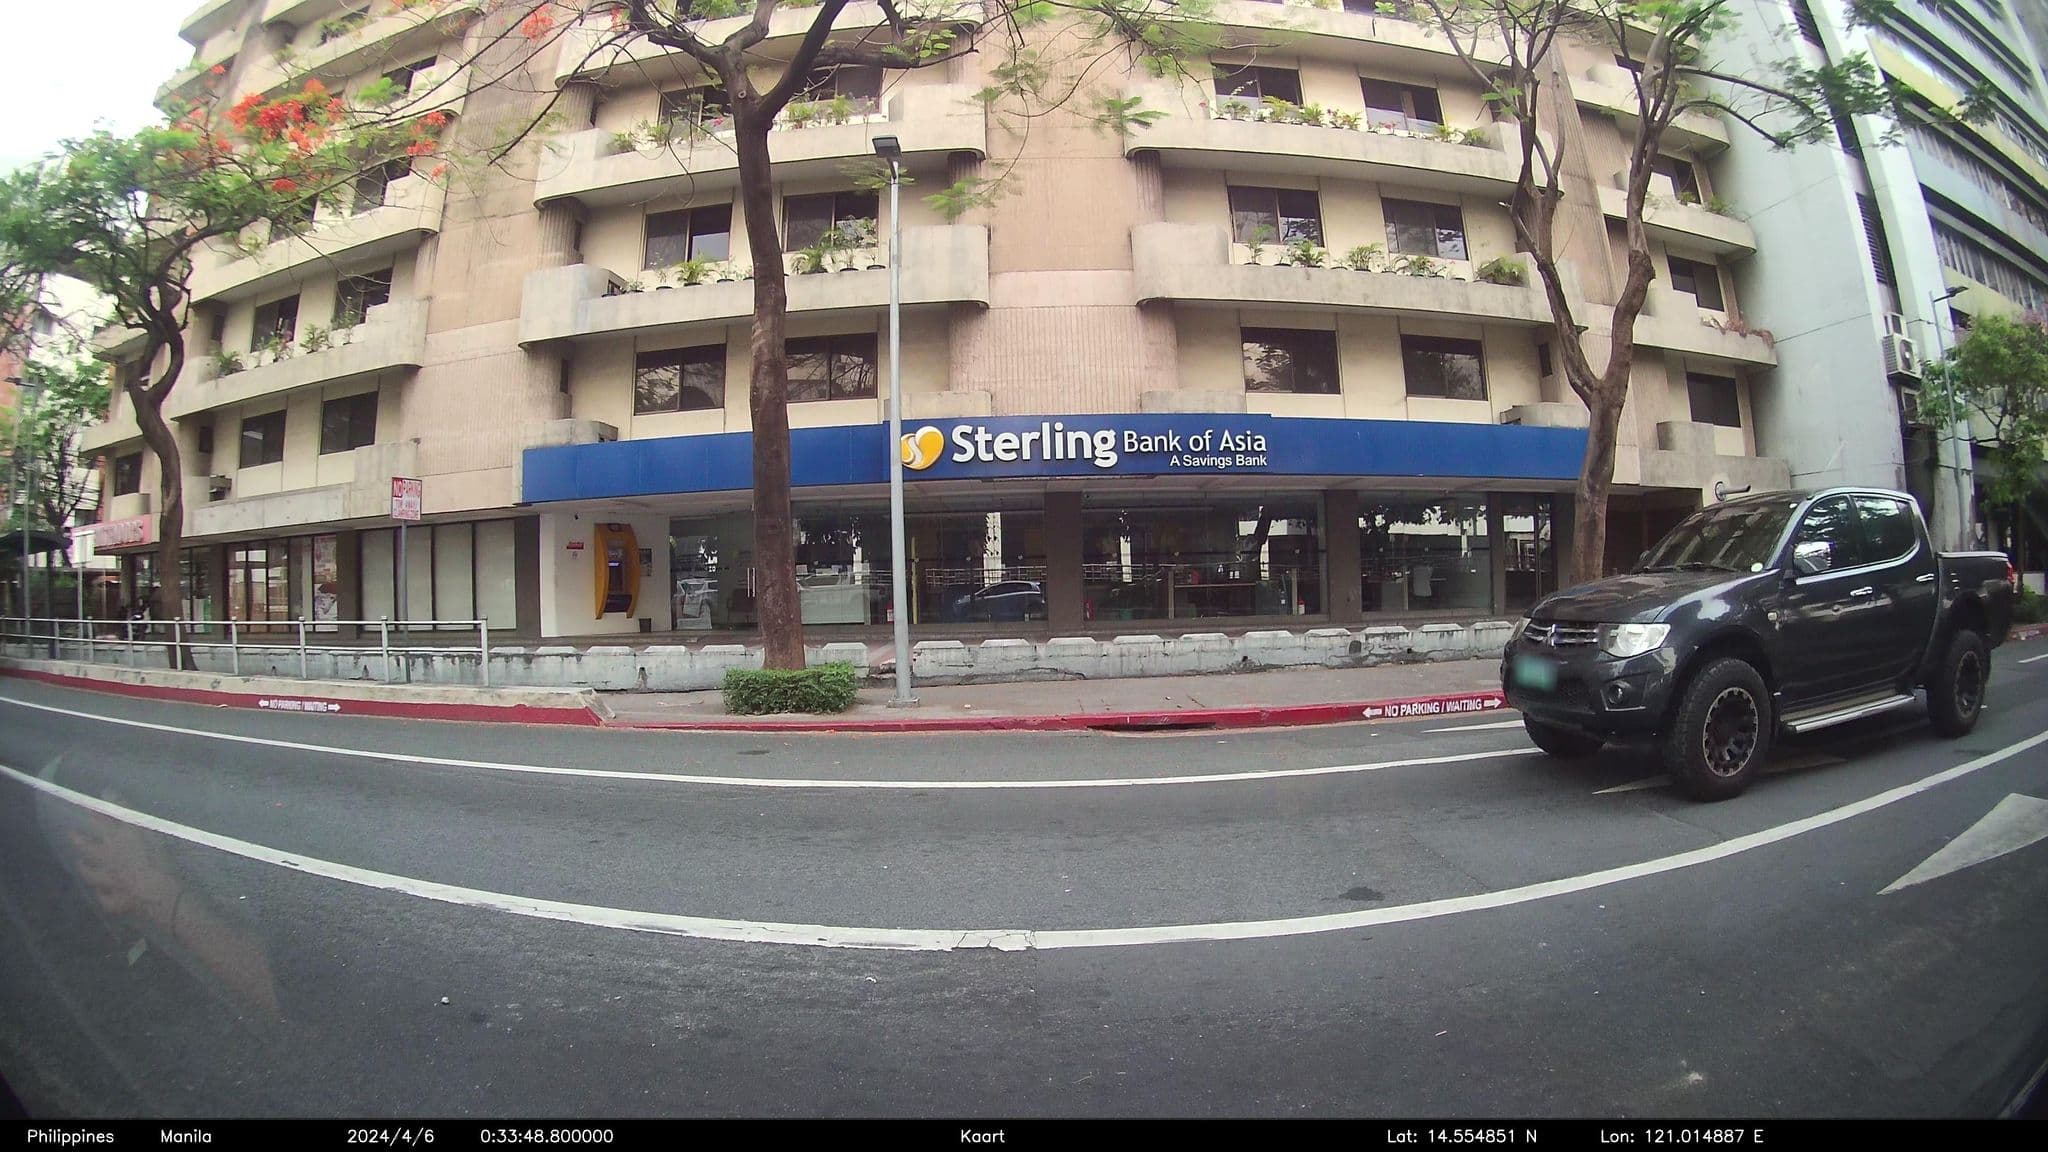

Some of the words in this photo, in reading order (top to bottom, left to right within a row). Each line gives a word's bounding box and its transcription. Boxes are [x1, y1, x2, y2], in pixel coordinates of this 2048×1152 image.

[951, 421, 1118, 468] Sterling
[1123, 429, 1183, 452] Bank
[1189, 429, 1214, 452] of
[1219, 429, 1267, 452] Asia
[1170, 455, 1181, 467] A
[1183, 454, 1233, 469] Savings
[1235, 454, 1268, 467] Bank
[1384, 705, 1398, 717] NO
[1400, 702, 1439, 716] PARKING
[1446, 699, 1482, 711] WAITING
